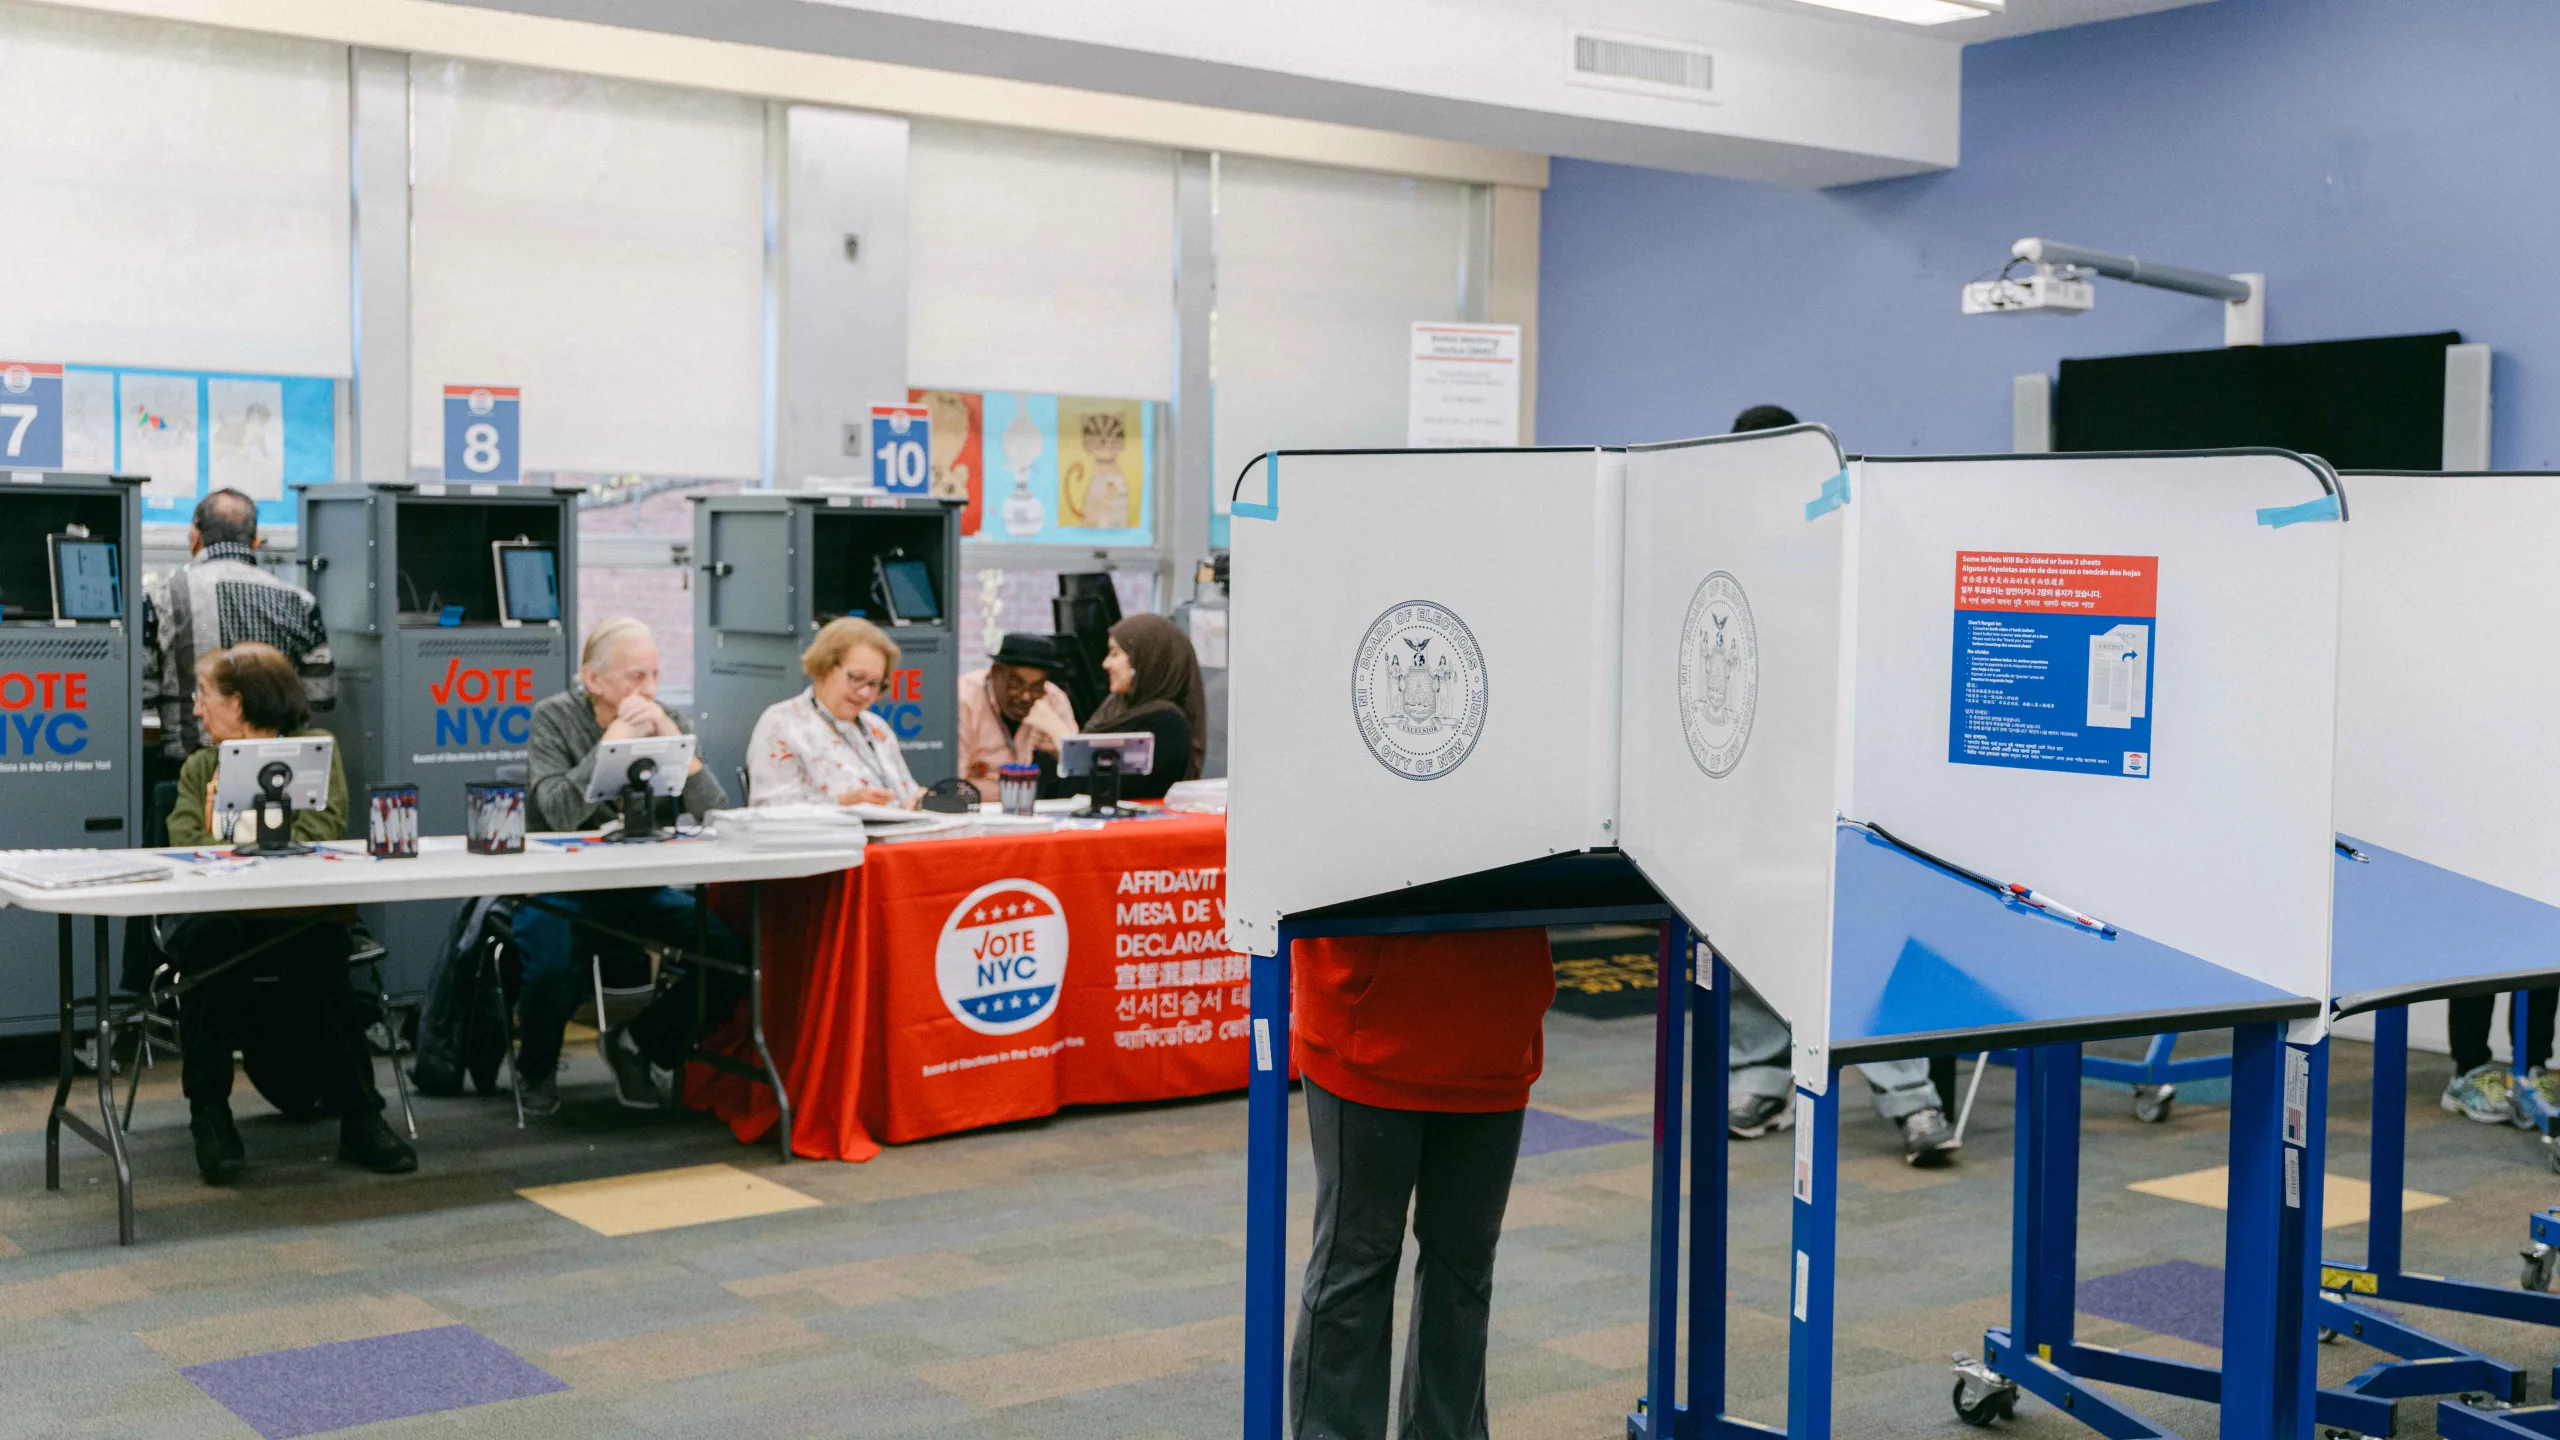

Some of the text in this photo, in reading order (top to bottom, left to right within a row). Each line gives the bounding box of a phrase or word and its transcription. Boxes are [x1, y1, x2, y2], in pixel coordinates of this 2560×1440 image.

[0, 404, 38, 457] 7
[463, 422, 500, 473] 8
[877, 441, 926, 487] 10
[1962, 565, 1987, 574] Algunas
[1988, 566, 2018, 575] Papeletas
[2122, 569, 2141, 578] hojas
[1361, 608, 1478, 671] BOARD OF ELECTIONS
[0, 712, 88, 756] YC
[436, 706, 531, 746] NYC
[1358, 688, 1482, 773] IN THE CITY OF NEW YORK
[1402, 725, 1438, 734] EXCELSIOR
[1116, 868, 1220, 894] AFFIDAVIT
[1116, 901, 1177, 926] MESA
[1182, 898, 1211, 923] DE
[977, 956, 1036, 987] NYC
[1115, 987, 1222, 1021] 선서진술서
[1029, 1046, 1049, 1059] City
